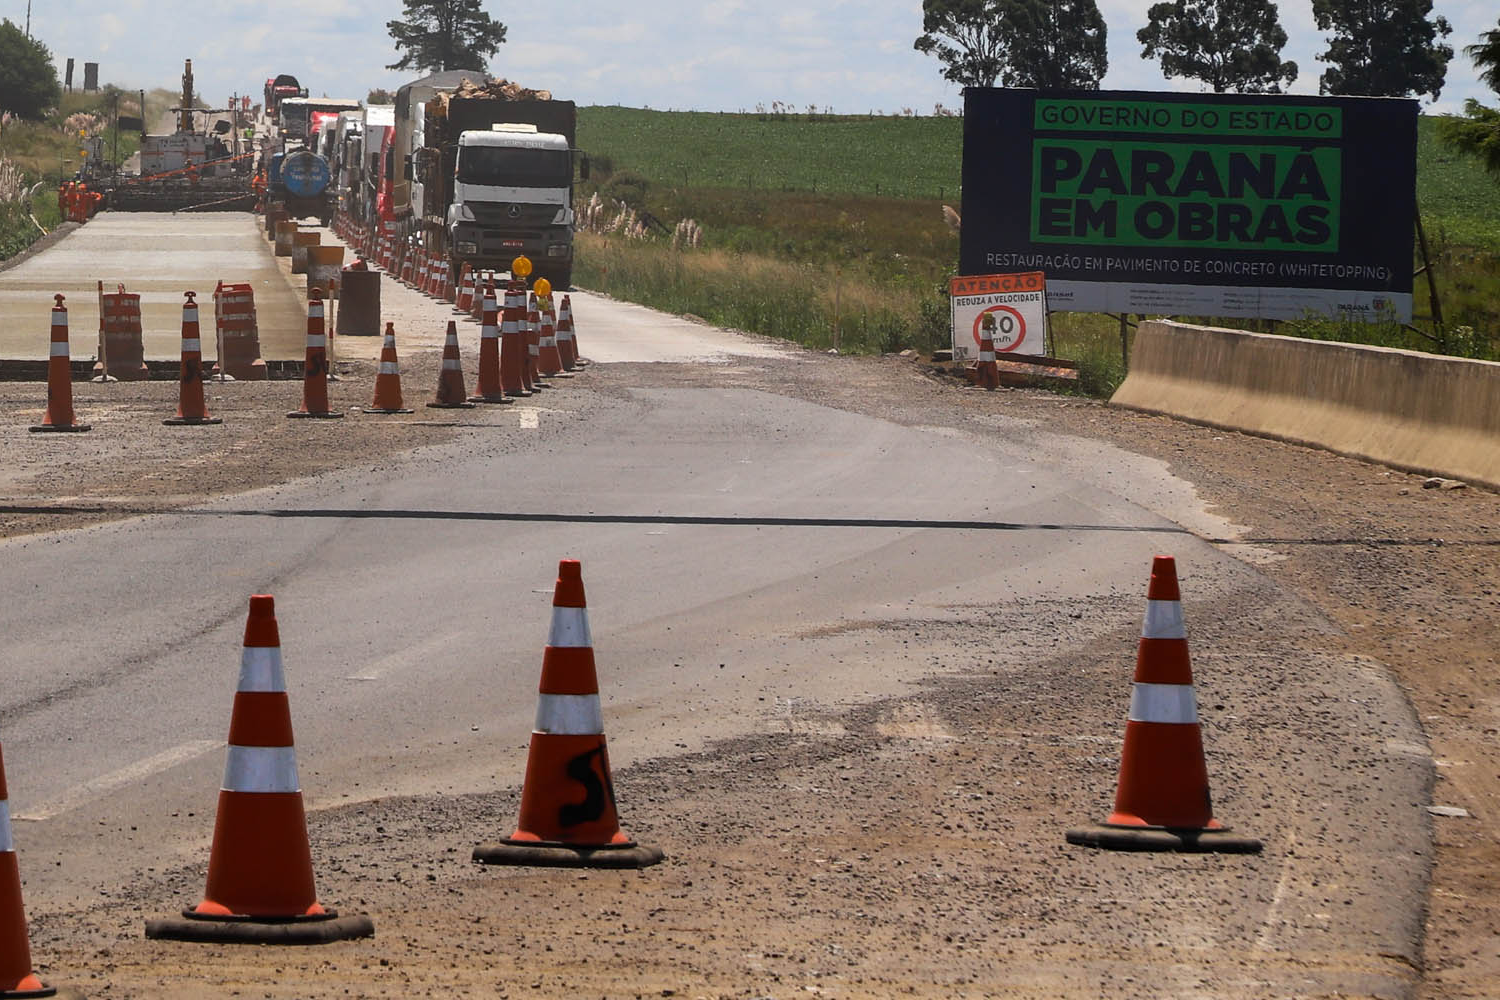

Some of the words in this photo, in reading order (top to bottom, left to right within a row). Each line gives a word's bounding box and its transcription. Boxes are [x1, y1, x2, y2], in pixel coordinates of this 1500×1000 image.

[1041, 105, 1171, 127] GOVERNO
[1181, 109, 1220, 129] DO
[1228, 111, 1334, 133] ESTADO
[1041, 145, 1330, 200] PARANÁ
[1039, 197, 1117, 238] EM
[1133, 200, 1331, 245] OBRAS
[986, 252, 1081, 270] RESTAURAÇÃO
[1084, 257, 1103, 270] EM
[1106, 257, 1180, 273] PAVIMENTO
[1184, 260, 1200, 273] DE
[1205, 260, 1276, 276] CONCRETO
[1279, 263, 1392, 281] (WHITETOPPING)
[956, 275, 1037, 293] ATENÇÃO
[956, 296, 986, 306] REDUZA
[987, 296, 993, 305] A
[994, 293, 1041, 304] VELOCIDADE
